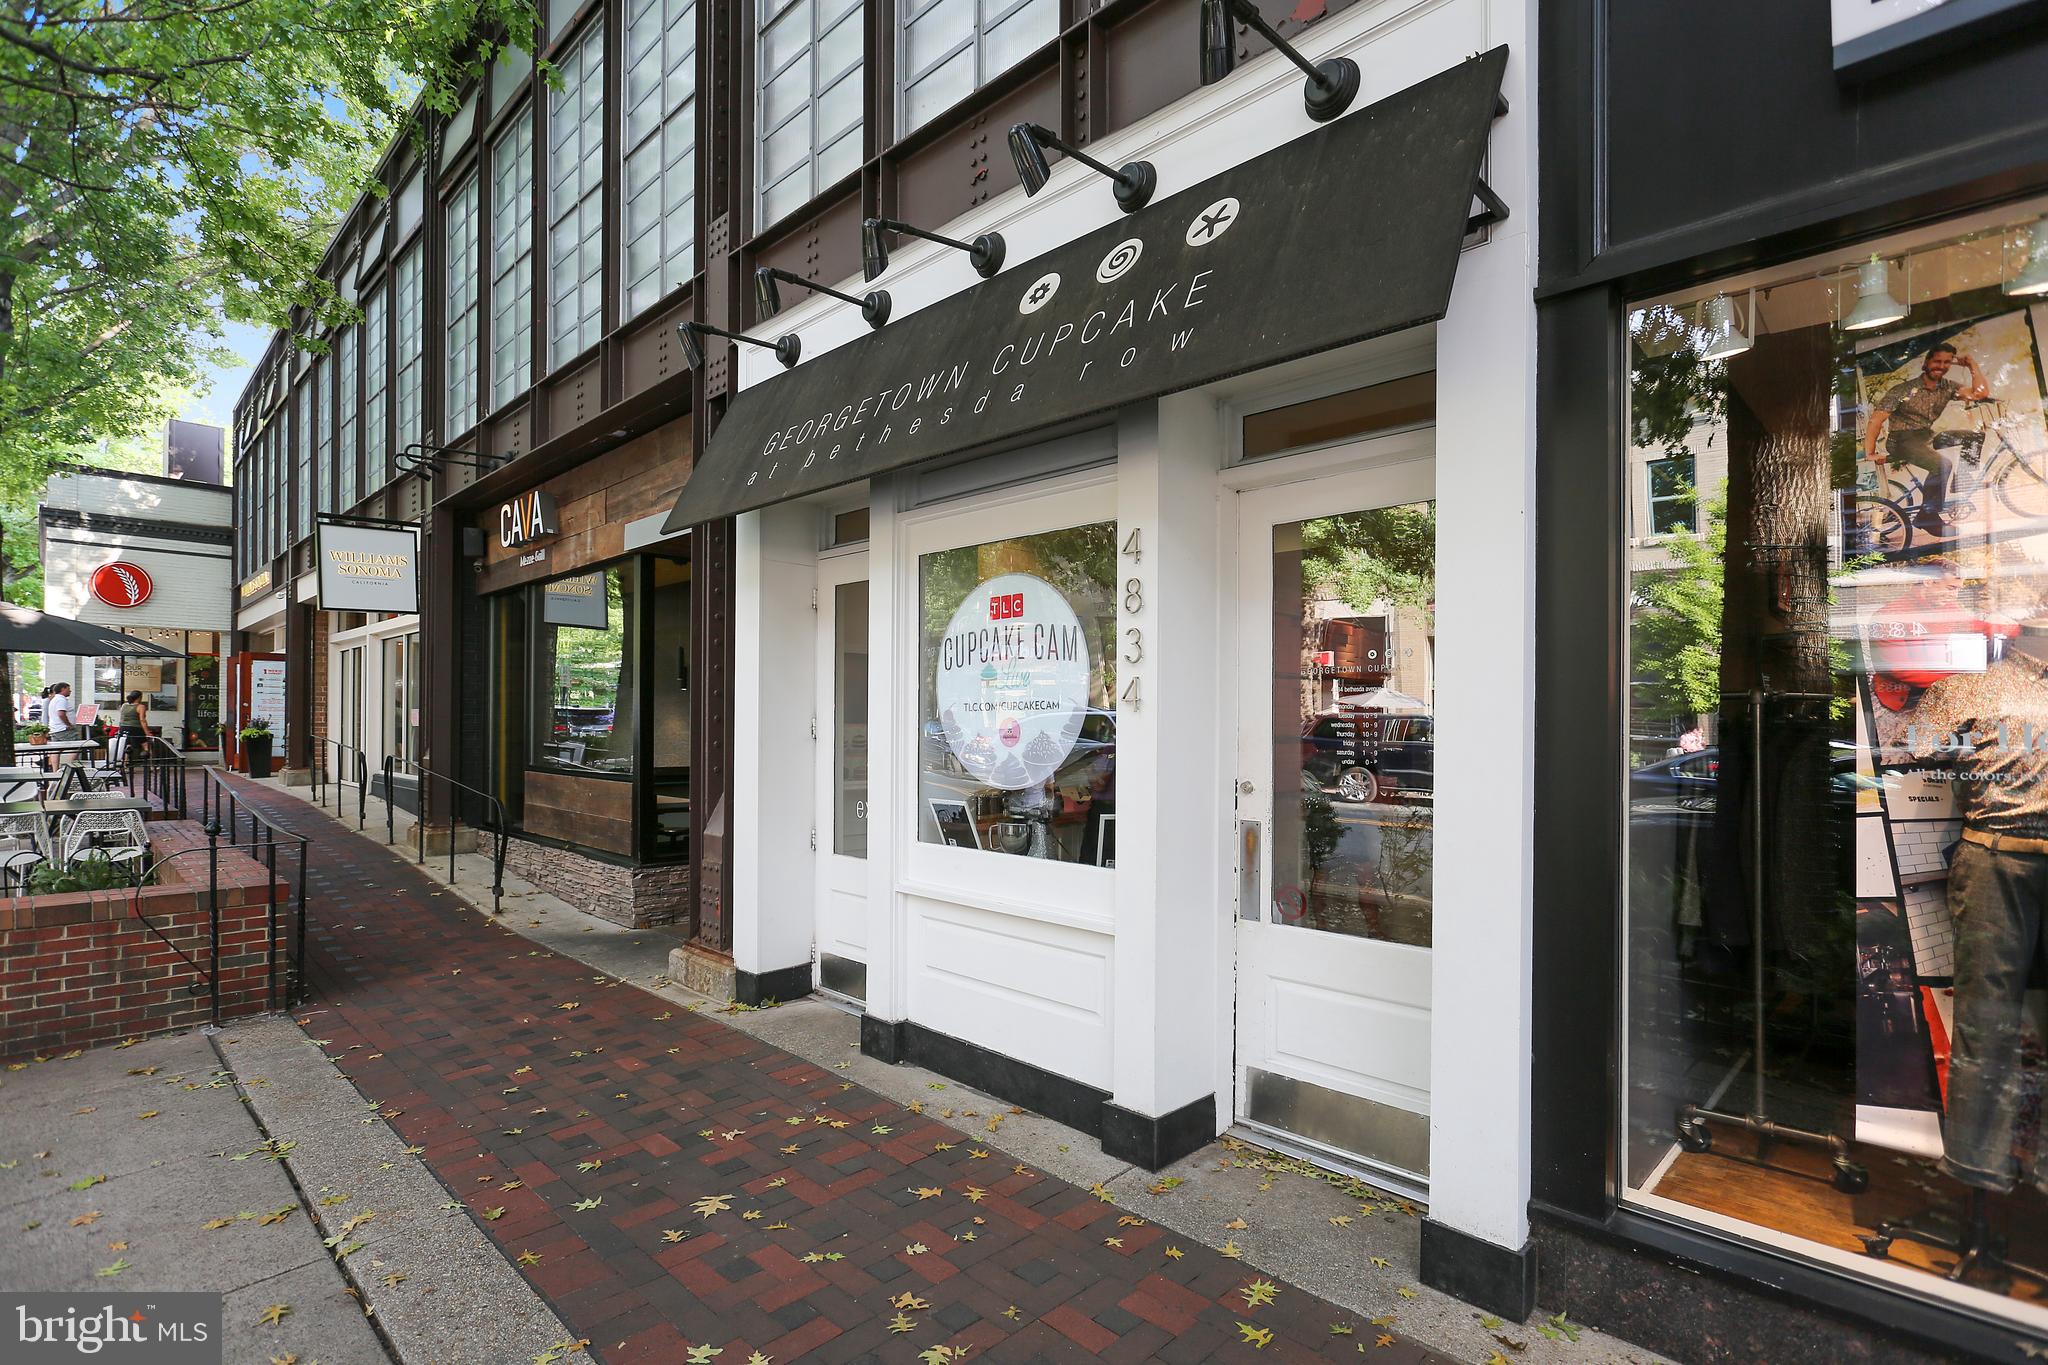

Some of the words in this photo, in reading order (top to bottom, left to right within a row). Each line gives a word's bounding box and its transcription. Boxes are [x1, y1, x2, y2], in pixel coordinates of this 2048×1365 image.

[762, 361, 970, 456] GEORGETOWN
[991, 269, 1213, 376] CUPCAKE
[746, 461, 778, 487] at
[803, 380, 1025, 470] bethesda
[1078, 326, 1195, 383] row
[500, 490, 544, 548] CAVA
[328, 549, 409, 568] WILLIAMS
[337, 564, 402, 579] SONOMA
[990, 598, 1022, 616] TLC
[1122, 527, 1146, 713] 4834
[944, 625, 1025, 671] CUPCAKE
[1034, 623, 1078, 663] CAM
[963, 700, 1060, 713] TLC.COM/CUPCAKECAM
[1930, 768, 1956, 781] the
[1908, 795, 1940, 803] SPECIALS
